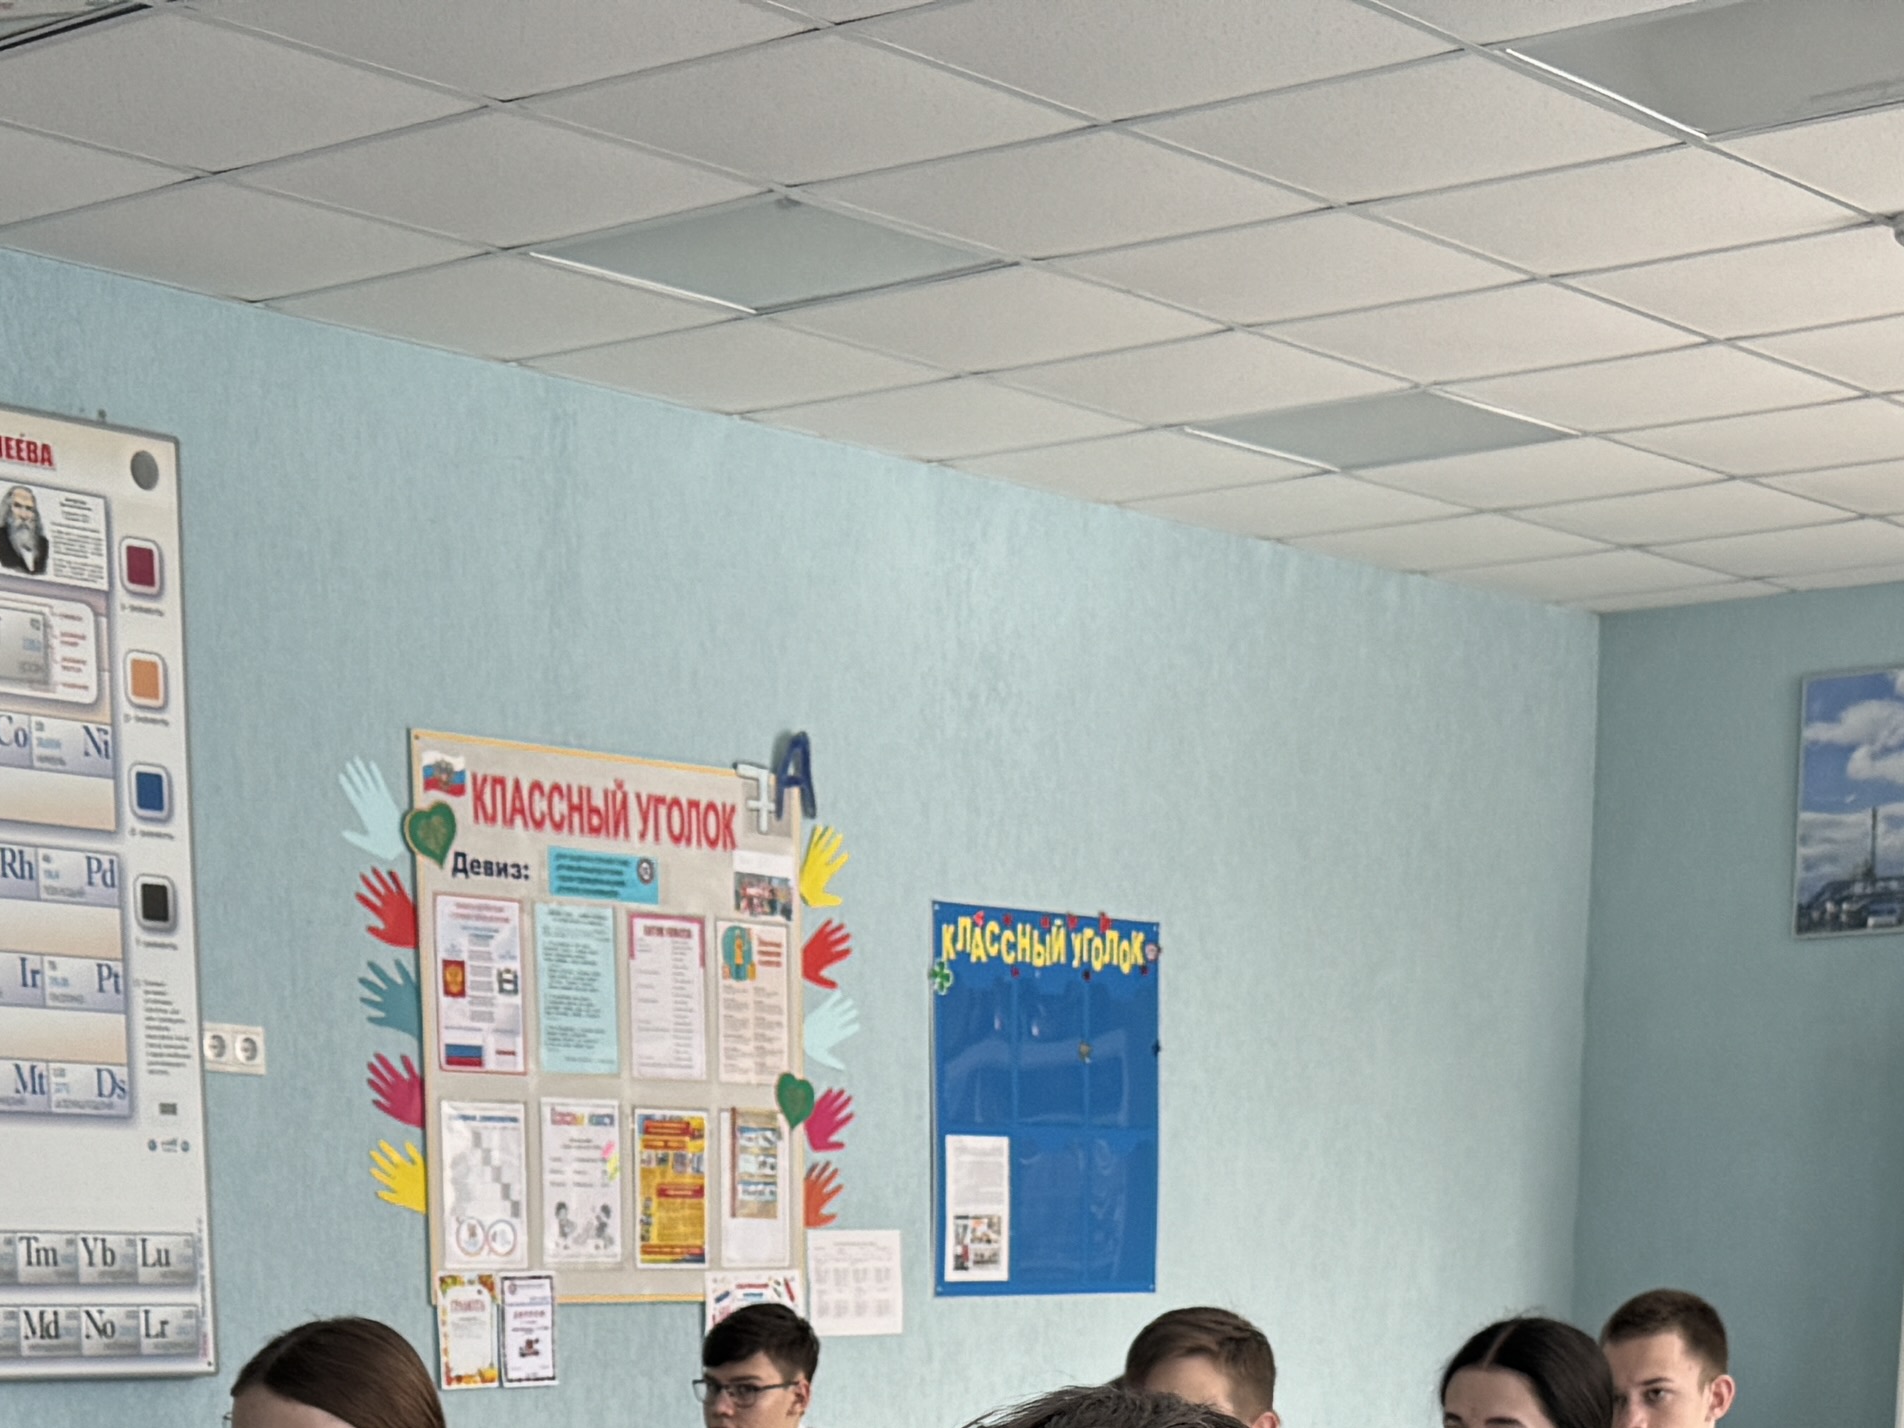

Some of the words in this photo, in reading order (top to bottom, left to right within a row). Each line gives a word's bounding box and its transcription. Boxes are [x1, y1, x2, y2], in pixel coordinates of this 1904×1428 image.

[82, 725, 110, 760] Ni
[733, 761, 775, 834] 7
[774, 731, 816, 820] А
[472, 772, 630, 841] КЛАССНЫЙ
[636, 792, 737, 852] УГОЛОК
[85, 855, 117, 889] Pd
[452, 851, 530, 881] Девиз:
[942, 916, 1067, 967] КЛАССНЫЙ
[1071, 928, 1146, 974] УГОЛОК
[20, 957, 41, 988] Ir
[96, 963, 121, 995] Pt
[96, 1068, 127, 1100] Ds
[19, 1236, 59, 1267] Tm
[80, 1237, 115, 1268] Yb
[140, 1237, 171, 1268] Lu
[23, 1309, 60, 1340] Md
[81, 1309, 116, 1339] No
[142, 1310, 169, 1339] Lr
